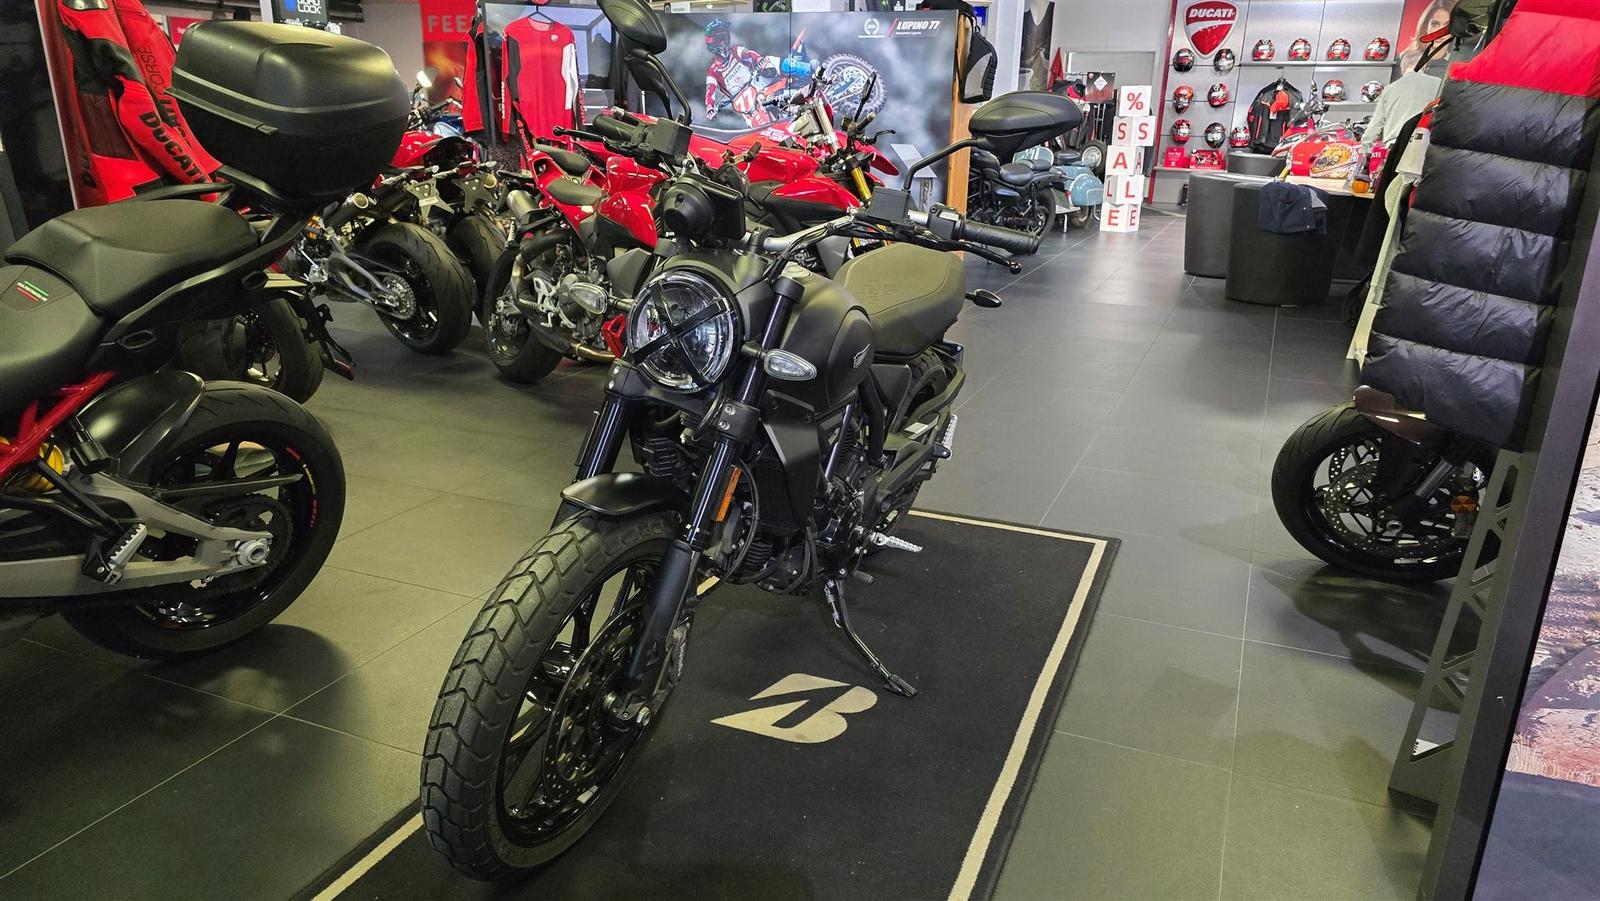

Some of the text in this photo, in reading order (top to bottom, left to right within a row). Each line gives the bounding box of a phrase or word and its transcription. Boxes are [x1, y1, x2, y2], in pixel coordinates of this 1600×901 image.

[297, 4, 321, 14] LOCK
[1188, 8, 1233, 18] DUCATI
[427, 15, 474, 33] FEE
[896, 20, 941, 30] LUPINO 77
[139, 111, 208, 184] DUCATI
